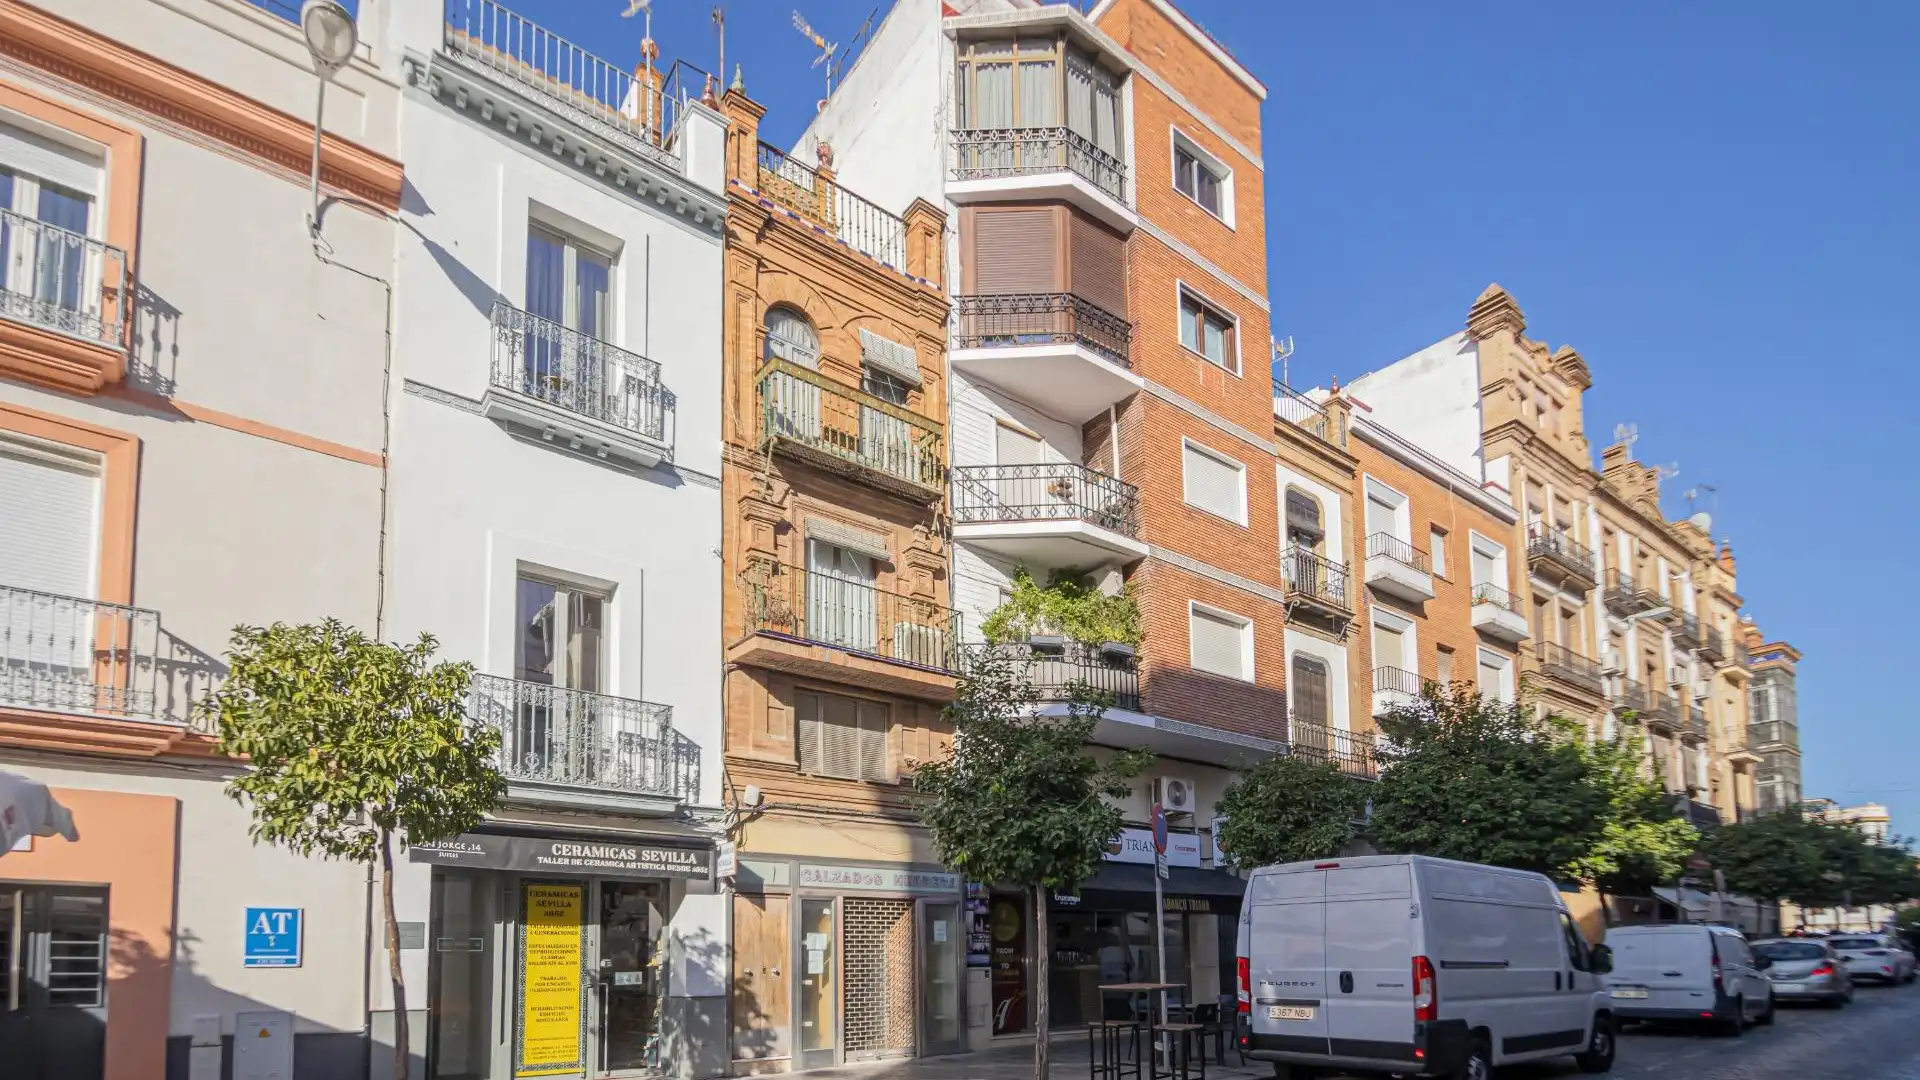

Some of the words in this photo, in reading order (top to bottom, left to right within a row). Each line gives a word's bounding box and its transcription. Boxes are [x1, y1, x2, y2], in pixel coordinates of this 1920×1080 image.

[437, 841, 466, 850] JORGE
[1126, 839, 1155, 853] TRIAN
[552, 843, 637, 860] CERAMICAS
[641, 850, 697, 864] SEVILLA
[537, 857, 570, 865] TALLER
[584, 859, 625, 868] CERAMICA
[626, 862, 666, 871] ARTISTICA
[667, 864, 691, 872] DESDE
[801, 868, 883, 886] CALZADOS
[529, 891, 580, 899] CERAMICAS
[536, 900, 572, 908] SEVILLA
[248, 911, 293, 935] AT
